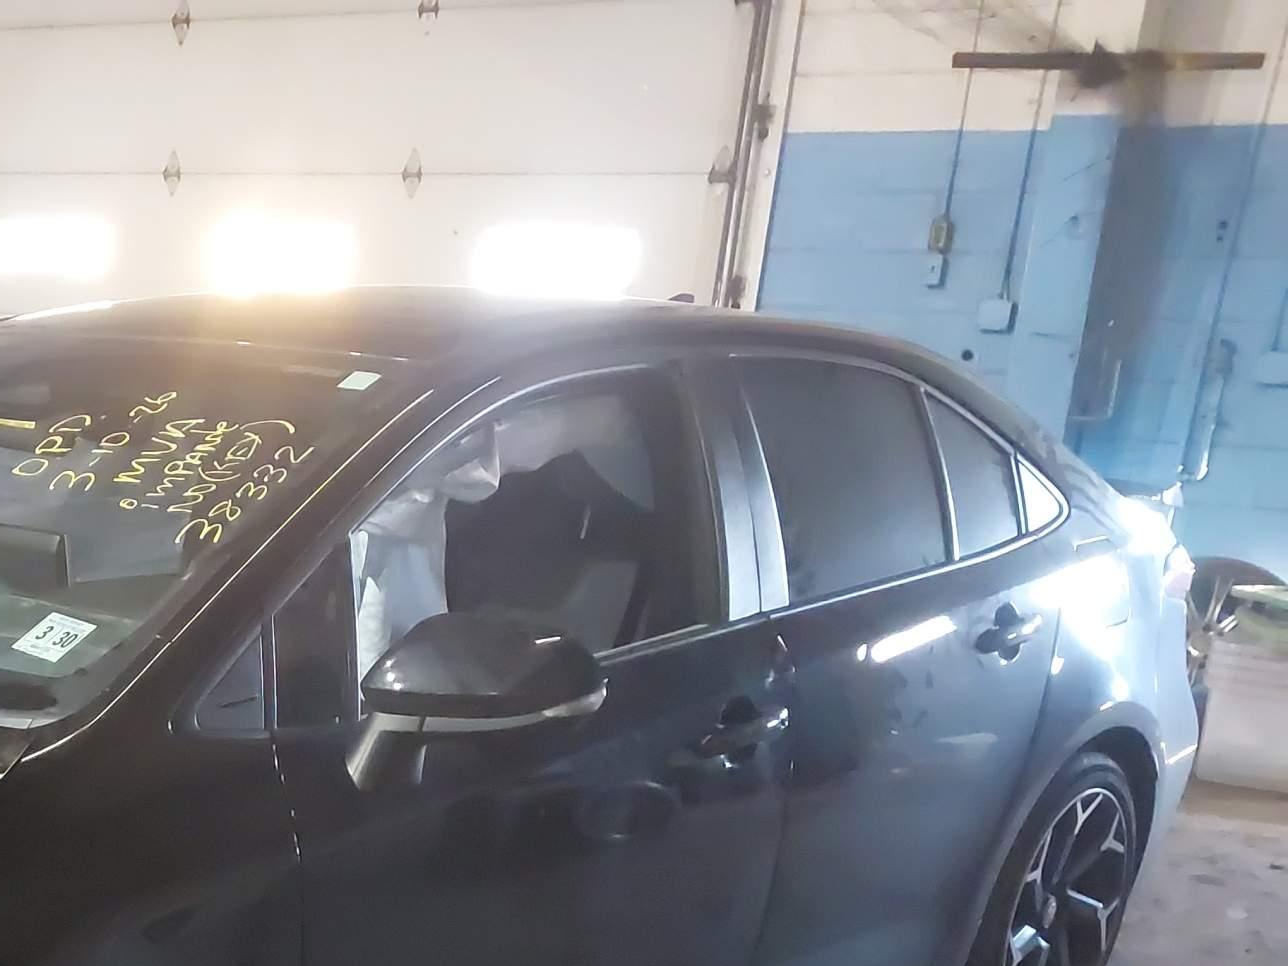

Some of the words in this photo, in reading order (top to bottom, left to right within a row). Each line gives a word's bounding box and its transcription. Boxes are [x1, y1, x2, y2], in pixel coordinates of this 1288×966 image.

[173, 444, 316, 545] 38332
[34, 625, 55, 641] 3
[51, 631, 80, 649] 30
